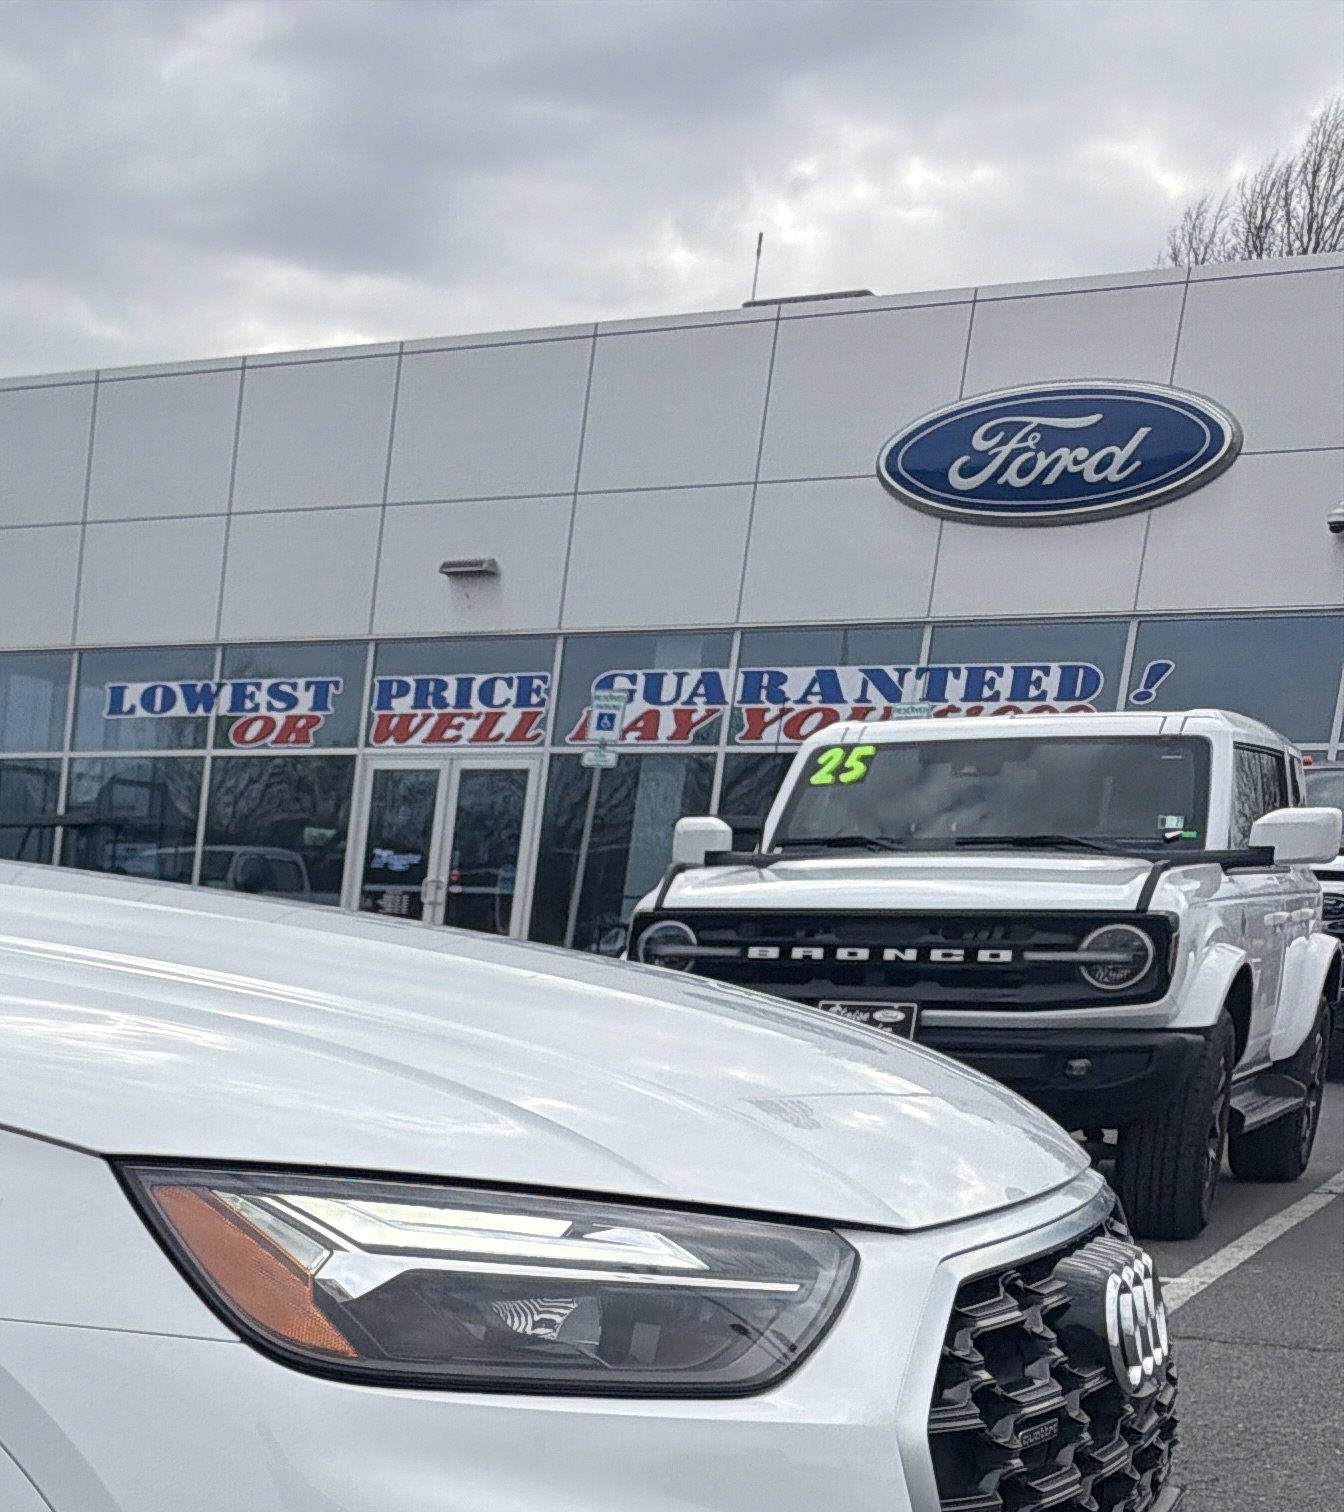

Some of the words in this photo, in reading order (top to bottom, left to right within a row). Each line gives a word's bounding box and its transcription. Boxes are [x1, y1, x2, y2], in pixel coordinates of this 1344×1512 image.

[948, 413, 1153, 491] Ford
[107, 680, 341, 716] LOWEST
[374, 675, 549, 711] PRICE
[594, 664, 1102, 706] GUARANTEED
[232, 714, 321, 745] OR
[372, 711, 544, 744] WE'LL
[810, 745, 877, 786] 25
[747, 946, 1013, 963] BRONCO
